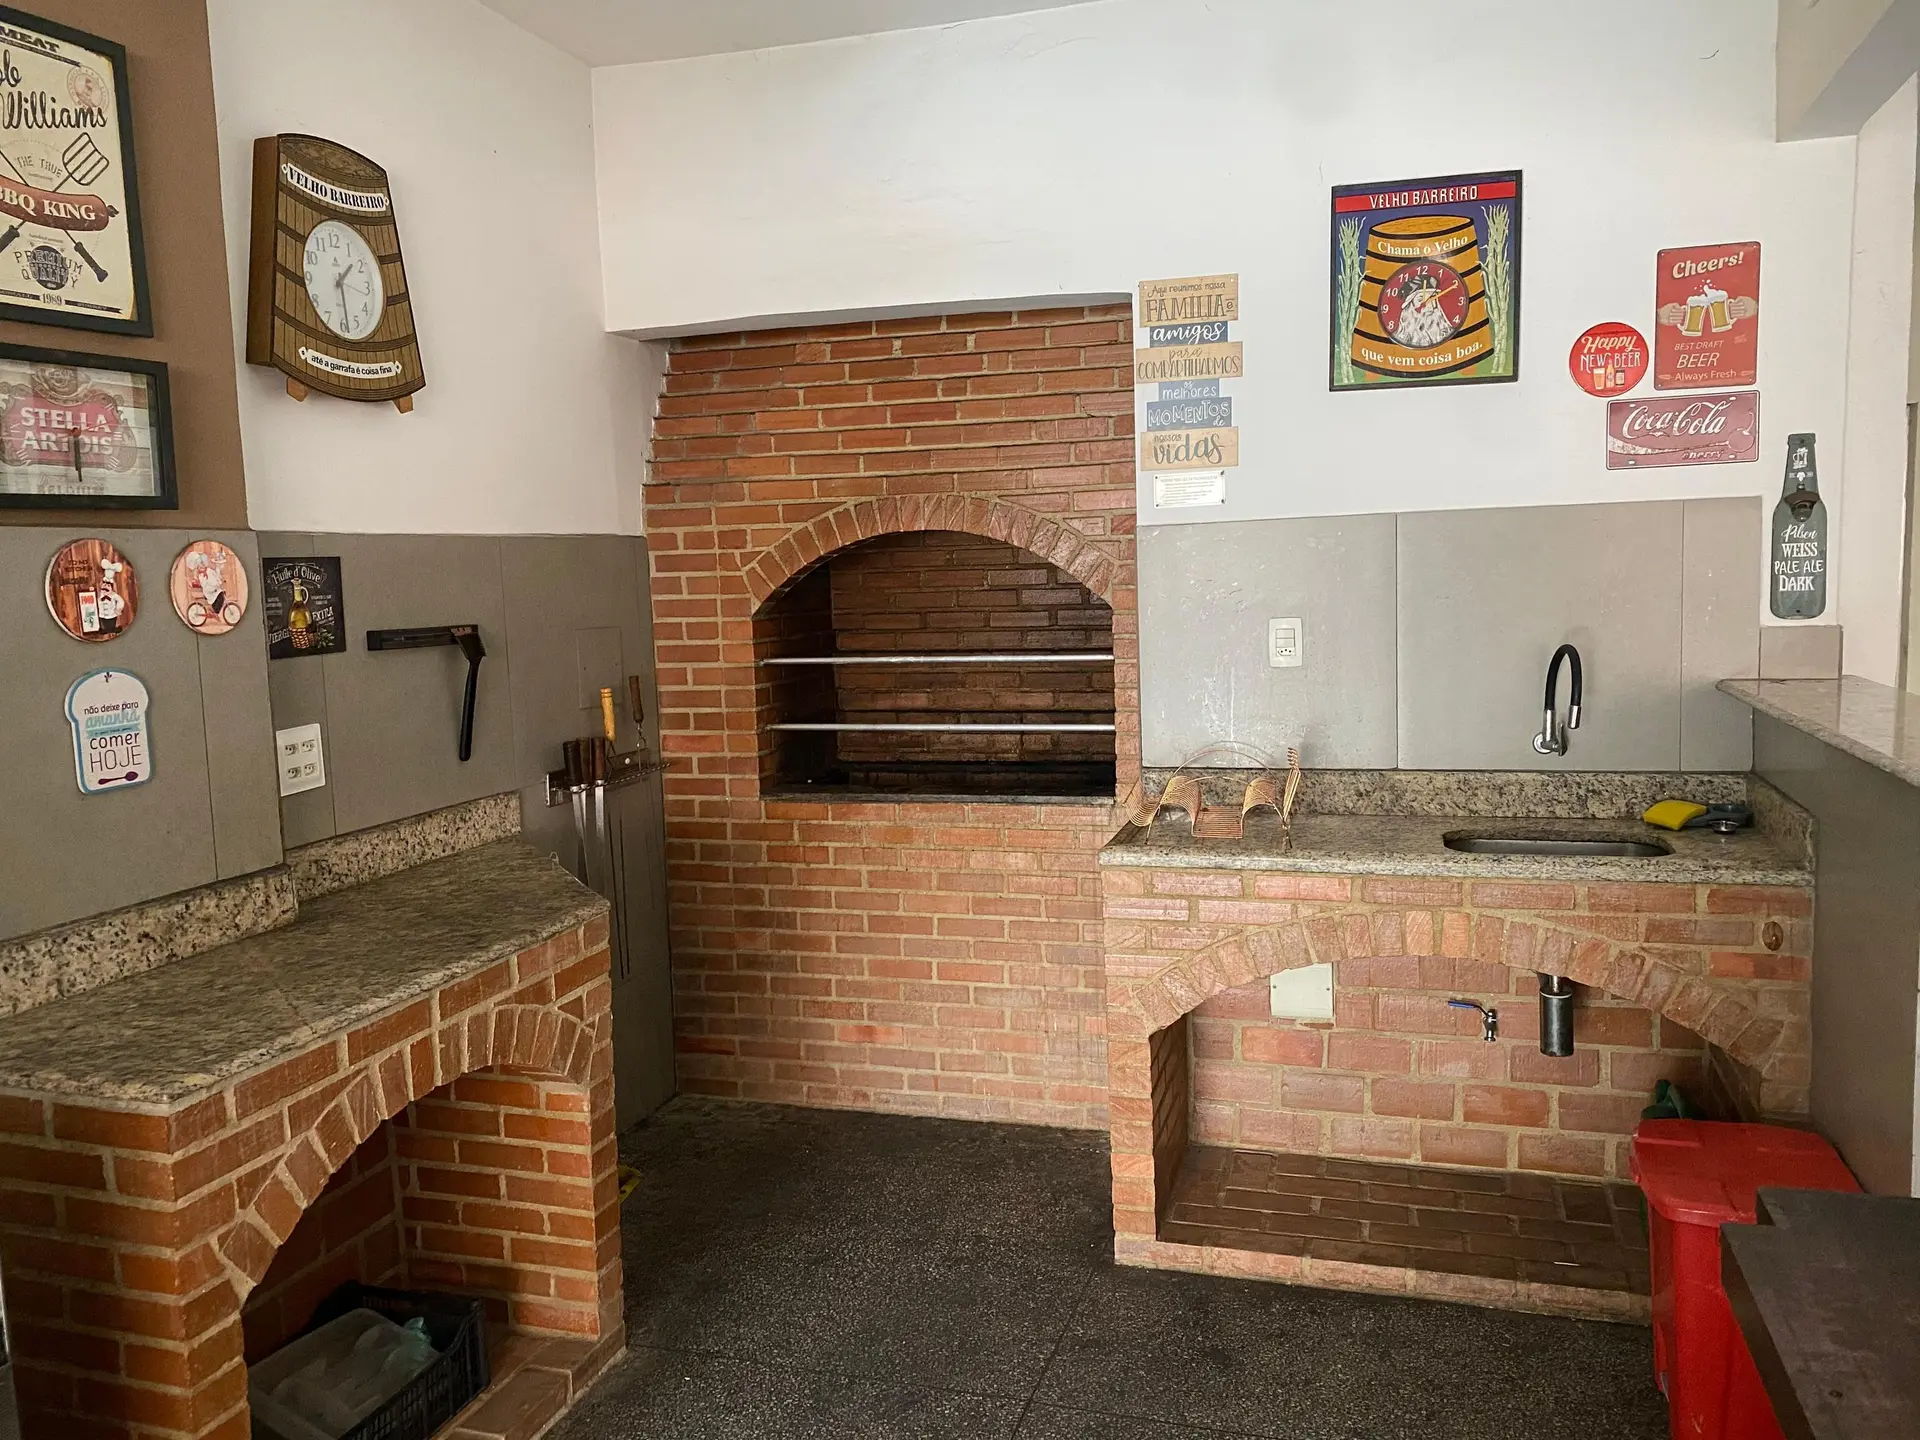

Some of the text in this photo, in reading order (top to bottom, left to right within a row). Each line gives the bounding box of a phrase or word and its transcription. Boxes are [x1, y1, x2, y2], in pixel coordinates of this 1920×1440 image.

[0, 26, 59, 53] MEAT
[0, 91, 108, 129] Williams
[14, 155, 63, 178] THE TRUE
[289, 167, 384, 208] VELHO BARREIRO
[1369, 186, 1478, 209] VELHO BARREIRO
[42, 199, 96, 219] KING
[328, 232, 340, 249] 12
[1377, 235, 1468, 256] Chama o Velho
[1416, 265, 1428, 275] 12
[1438, 268, 1443, 278] 1
[1672, 251, 1744, 279] Cheers!
[1205, 281, 1226, 290] nossa
[1398, 273, 1409, 282] 11
[1386, 287, 1398, 297] 10
[1382, 304, 1389, 314] 9
[1457, 296, 1464, 306] 3
[1388, 320, 1395, 330] 8
[1453, 315, 1460, 324] 4
[1153, 322, 1226, 344] amigos
[1581, 335, 1640, 354] Happy
[1674, 340, 1724, 351] BEST DRAFT
[1169, 347, 1202, 360] para
[1361, 342, 1483, 367] que vem coisa boa.
[1580, 351, 1641, 373] NEW BEER
[1676, 352, 1720, 369] BEER
[311, 355, 324, 365] até
[330, 362, 355, 374] garrafa
[361, 366, 379, 376] coisa
[380, 365, 392, 374] fina
[1674, 369, 1737, 381] Always Fresh
[1162, 386, 1217, 400] melhores
[20, 407, 111, 433] STELLA
[1148, 400, 1231, 427] MOMENTOS
[1213, 415, 1225, 426] de
[1622, 400, 1732, 439] Coca-Cola
[1154, 433, 1182, 443] nossas
[1153, 433, 1226, 465] vidas
[1782, 542, 1818, 558] WEISS
[272, 566, 293, 584] Huile
[1774, 560, 1824, 575] PALE ALE
[1779, 575, 1815, 592] DARK
[312, 606, 334, 621] EXTRA
[84, 701, 139, 715] não deixe para
[90, 733, 140, 750] comer
[90, 745, 142, 773] HOJE
